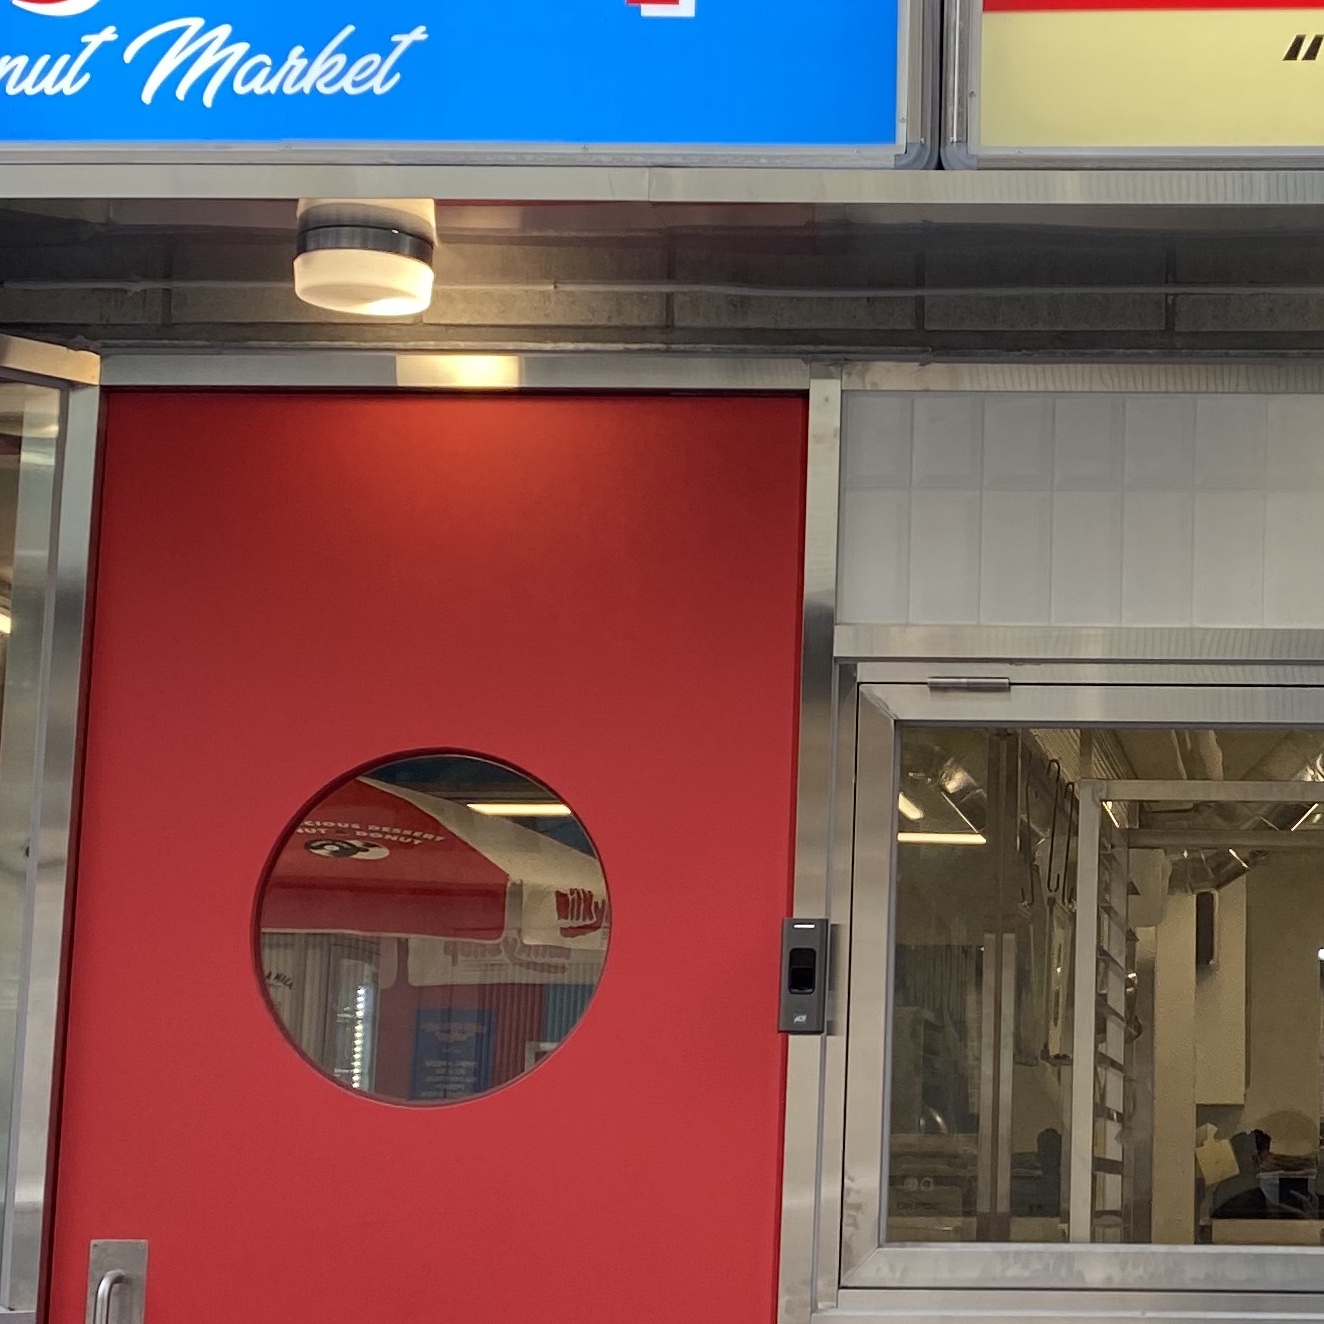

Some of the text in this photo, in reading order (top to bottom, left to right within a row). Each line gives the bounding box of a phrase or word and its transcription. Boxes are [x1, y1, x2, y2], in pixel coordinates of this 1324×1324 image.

[0, 17, 429, 108] nut Market
[300, 820, 361, 830] CIOUS
[355, 830, 423, 846] DONUT
